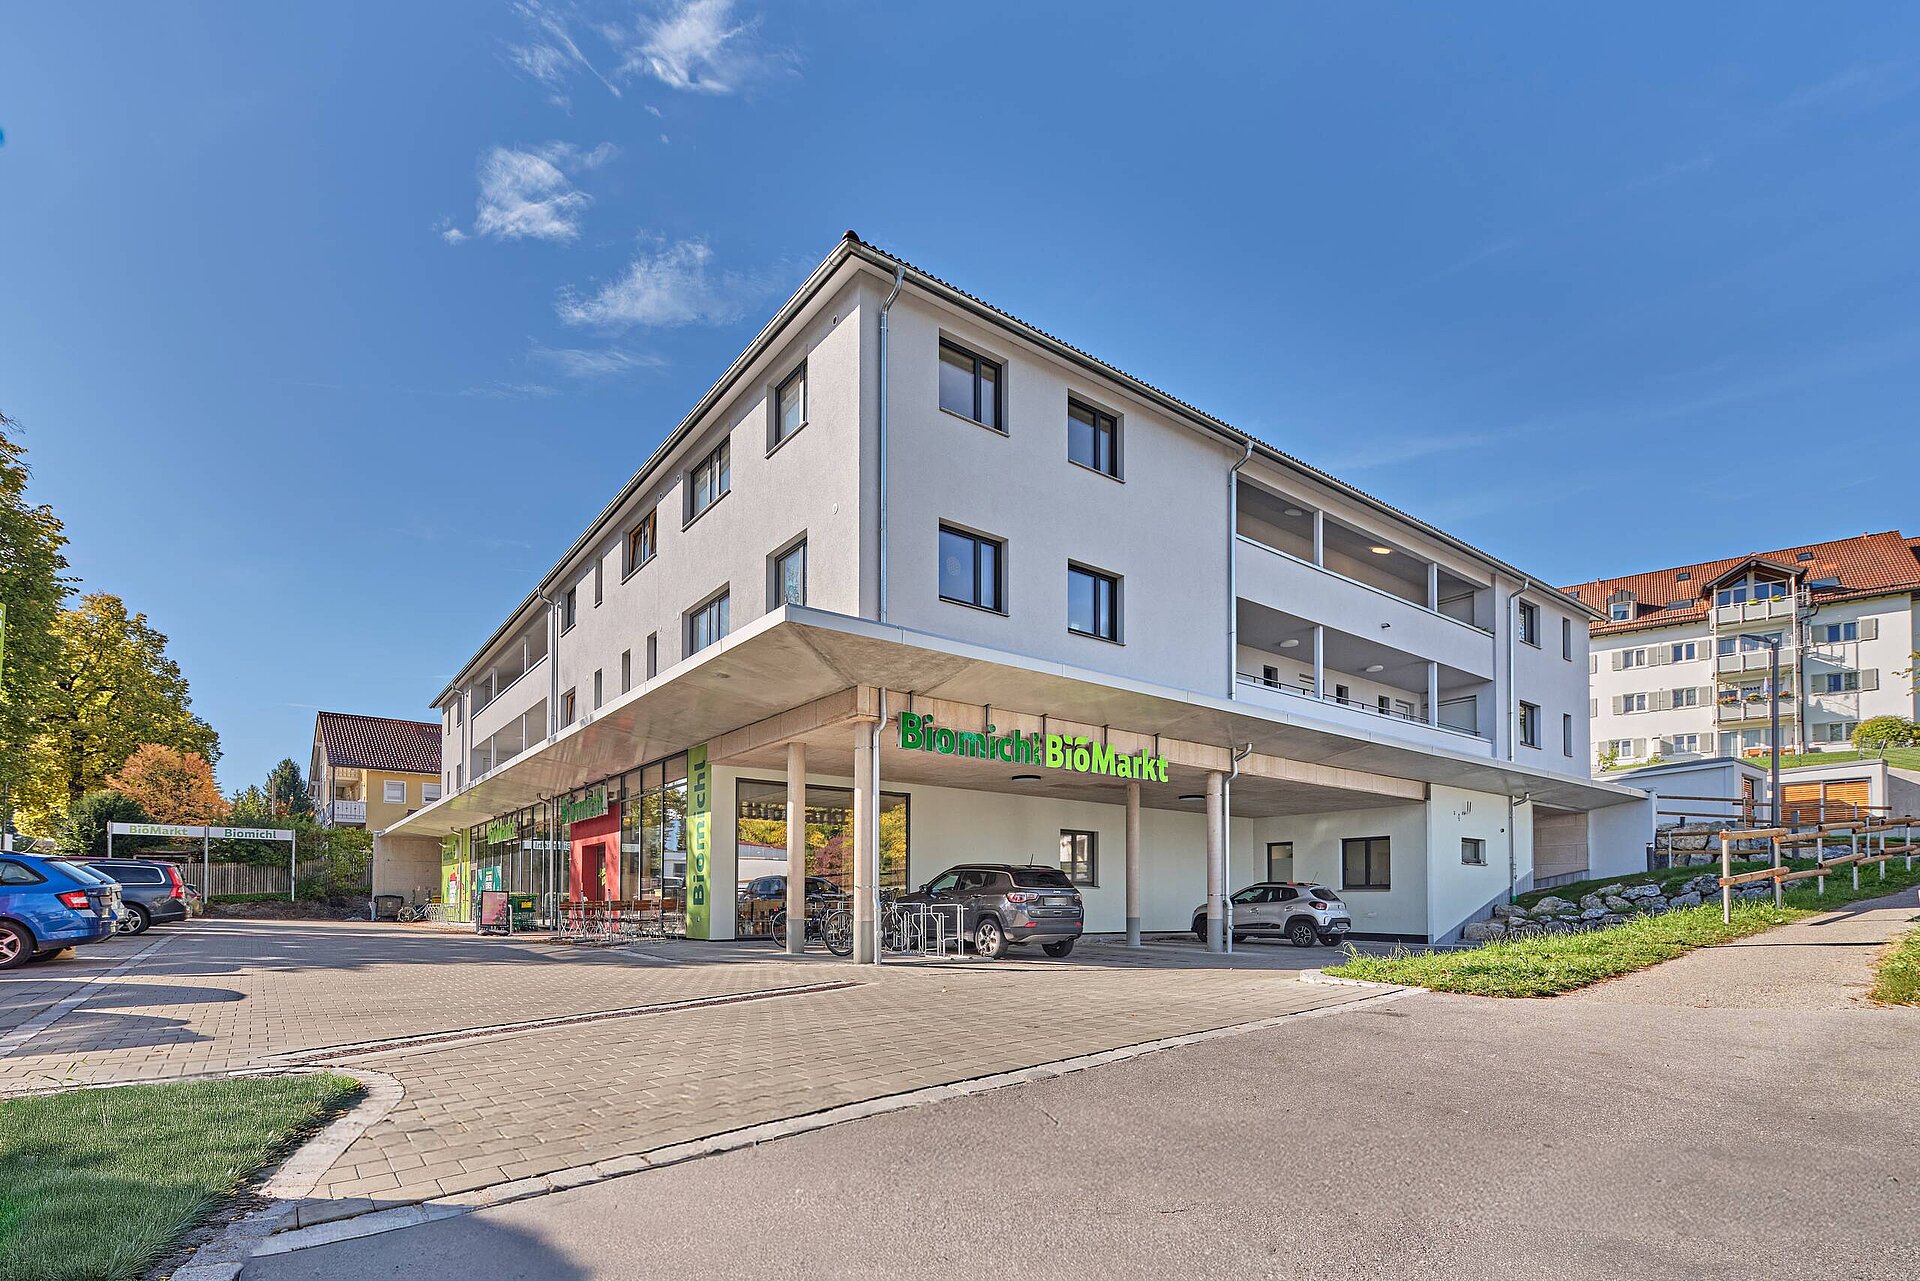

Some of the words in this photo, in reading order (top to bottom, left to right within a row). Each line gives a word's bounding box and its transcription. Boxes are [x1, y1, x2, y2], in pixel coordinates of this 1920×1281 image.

[900, 711, 1041, 766] Biomichl
[224, 828, 276, 839] Biomichl
[693, 760, 707, 906] Biomichl
